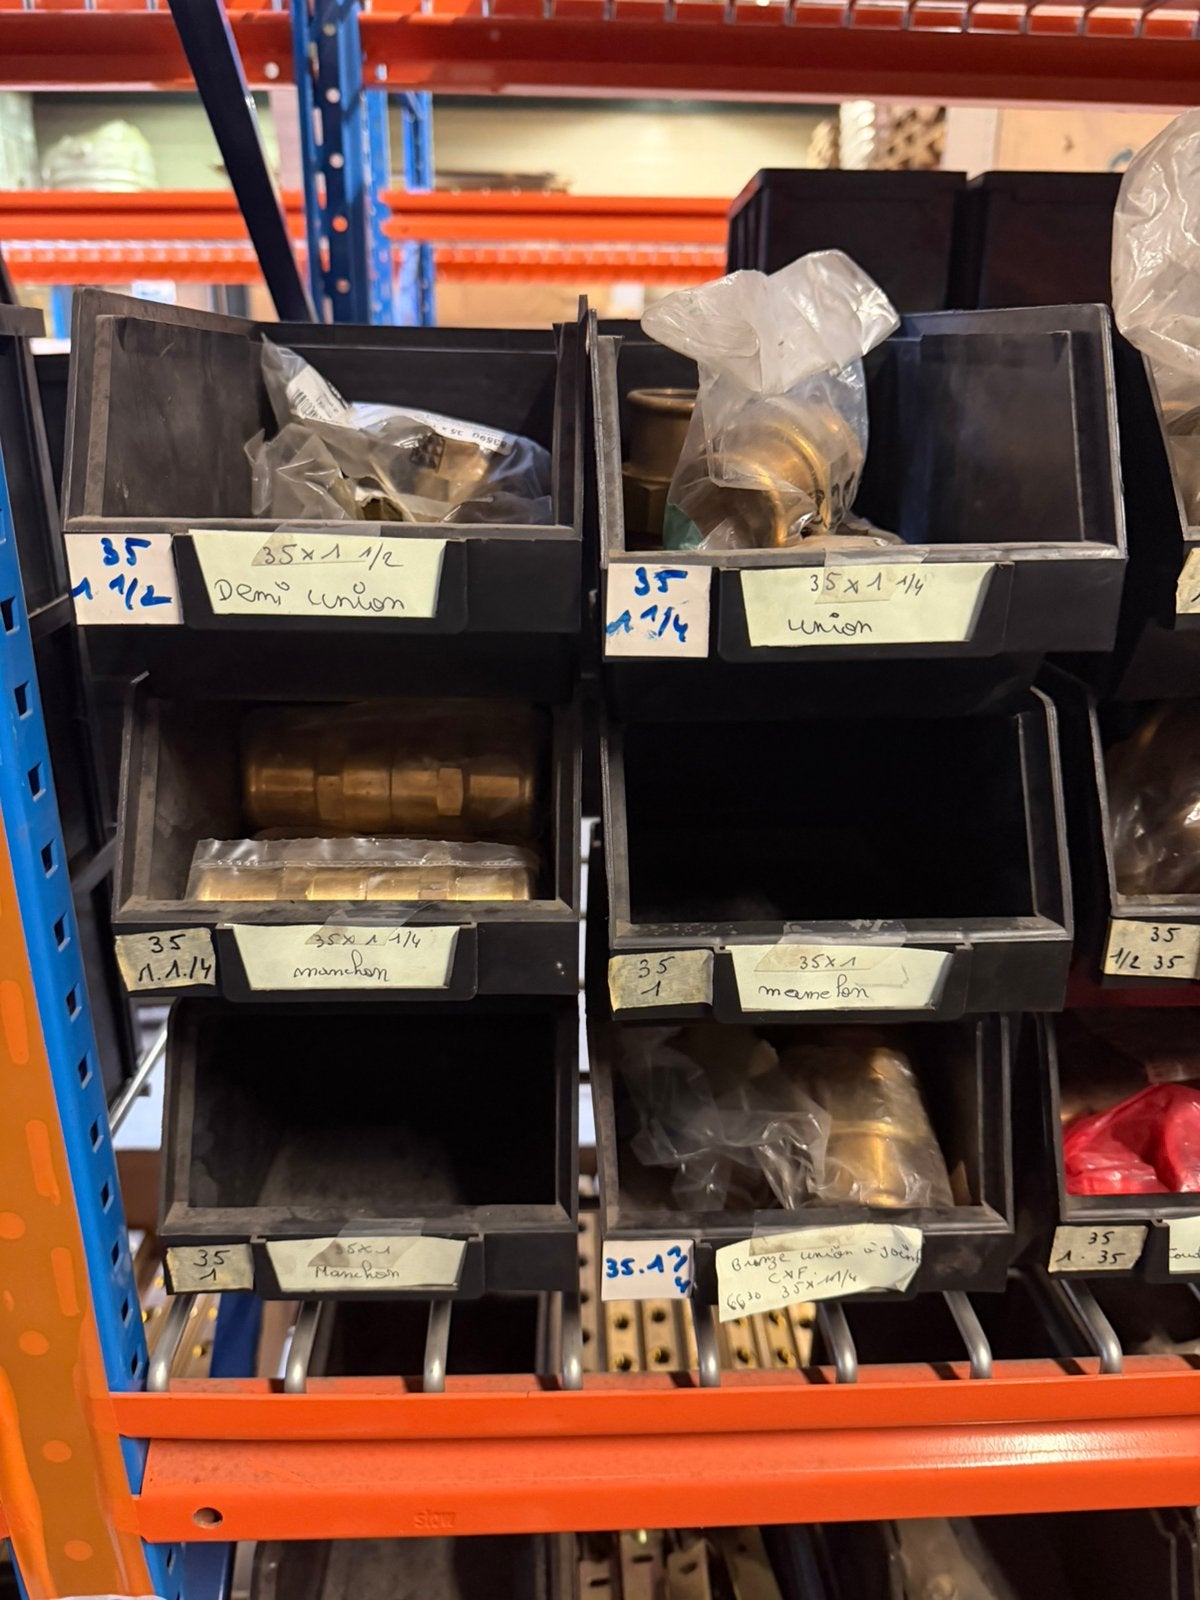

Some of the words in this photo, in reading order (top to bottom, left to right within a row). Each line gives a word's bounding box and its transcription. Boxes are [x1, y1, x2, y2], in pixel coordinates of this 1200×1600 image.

[100, 537, 151, 566] 35
[71, 578, 93, 600] 1
[108, 574, 173, 612] 1/2
[634, 566, 689, 597] 35
[214, 578, 291, 607] Demi
[307, 581, 406, 612] union
[640, 604, 690, 643] 1/4
[787, 612, 873, 636] union
[148, 934, 187, 954] 35
[1150, 926, 1182, 943] 35
[293, 949, 389, 982] manchon
[637, 956, 676, 978] 35
[1109, 947, 1142, 970] 1/2
[1153, 955, 1186, 971] 35
[640, 981, 662, 997] 1
[1088, 1231, 1115, 1245] 35
[193, 1249, 231, 1267] 35
[1098, 1250, 1126, 1264] 35
[200, 1269, 217, 1281] 1
